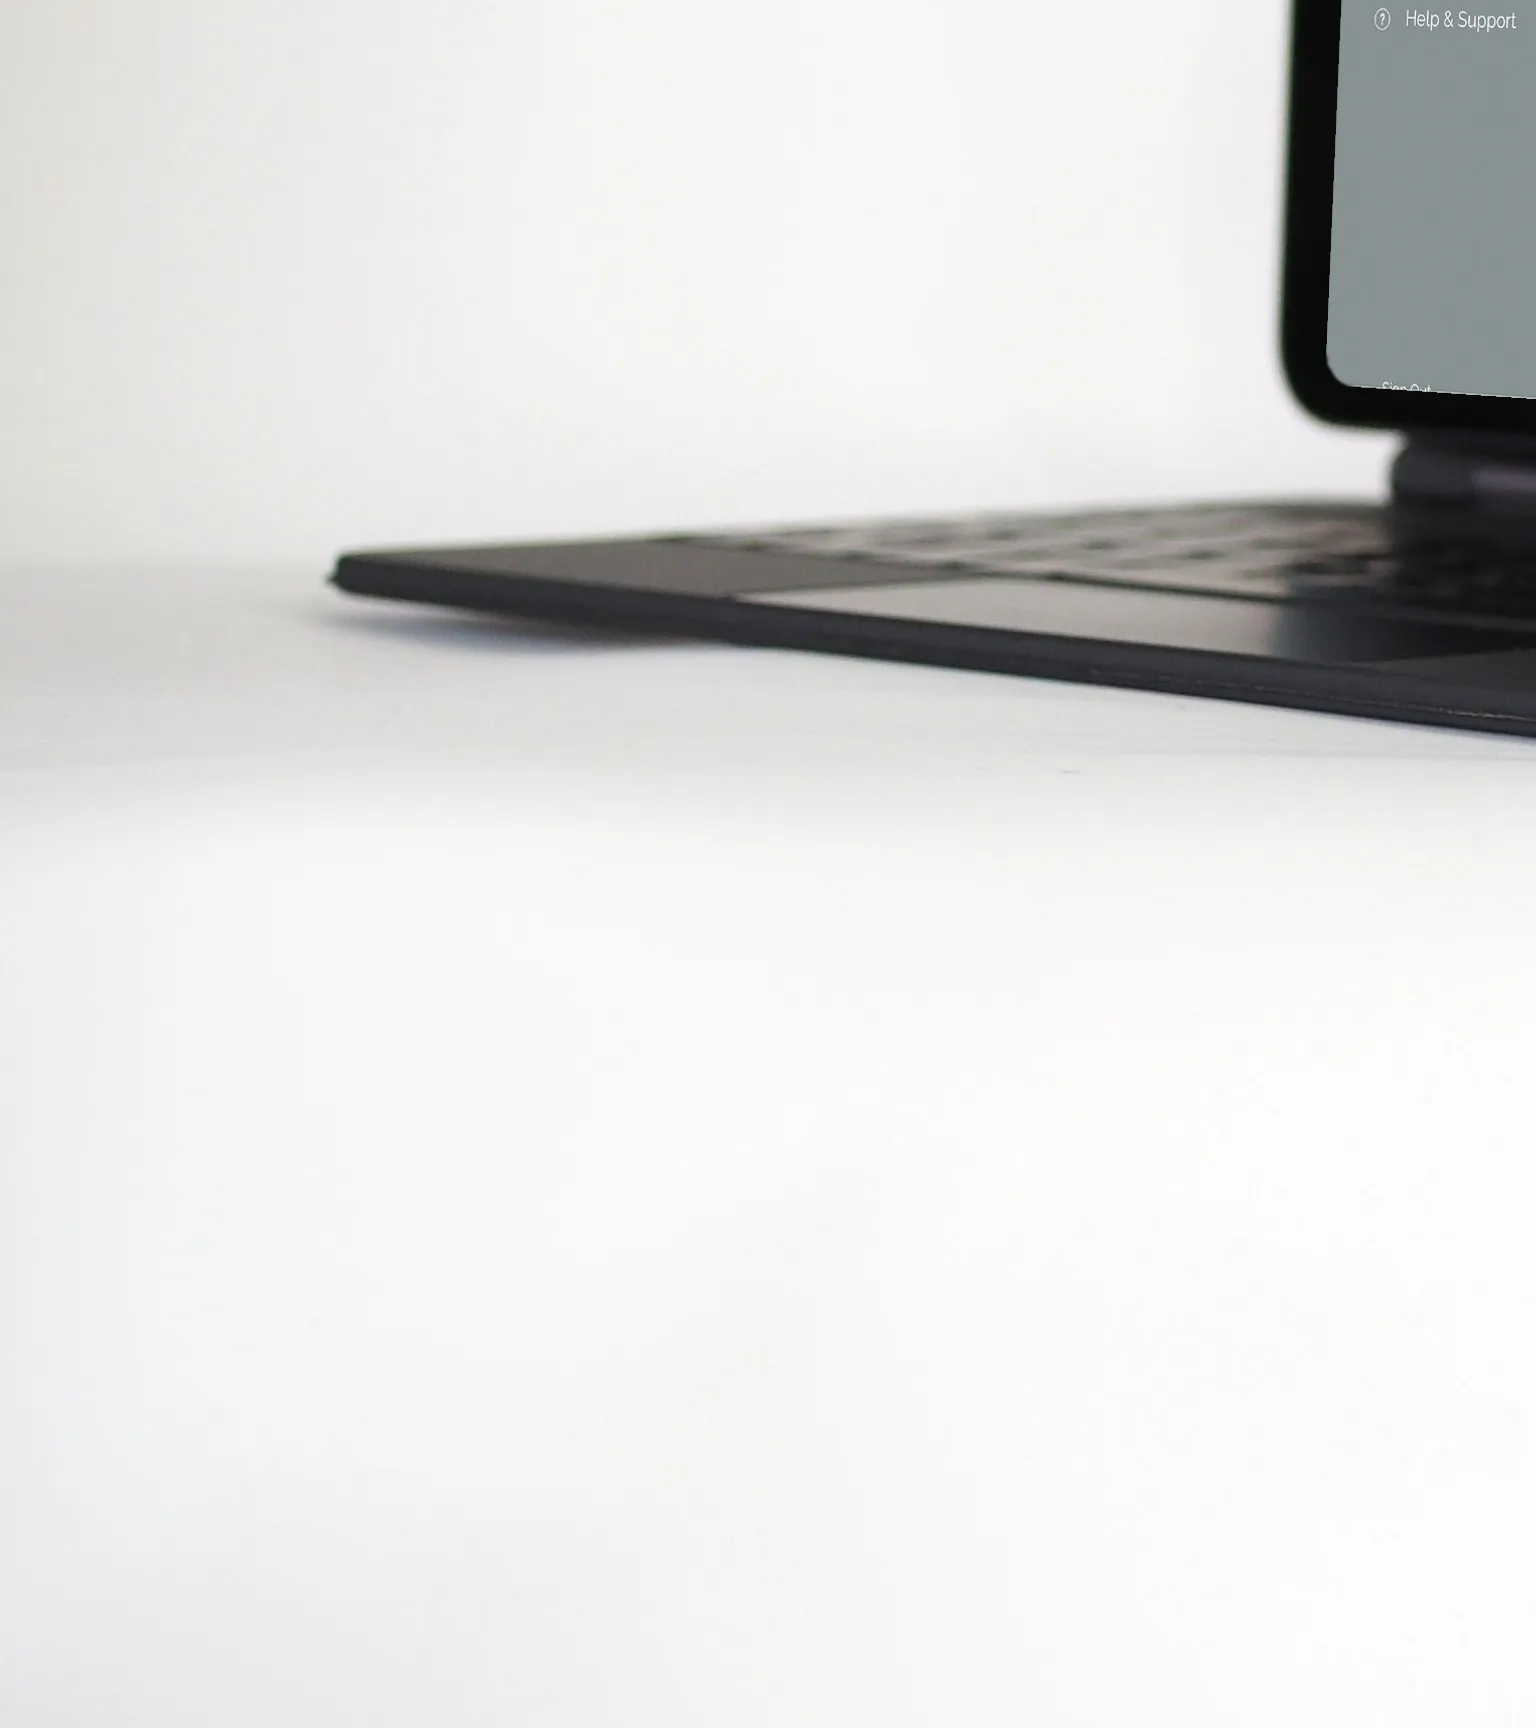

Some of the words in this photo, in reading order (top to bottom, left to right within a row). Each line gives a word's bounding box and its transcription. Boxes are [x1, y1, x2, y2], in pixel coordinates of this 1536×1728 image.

[1406, 10, 1437, 31] Help
[1442, 12, 1454, 27] &
[1458, 11, 1516, 32] Support
